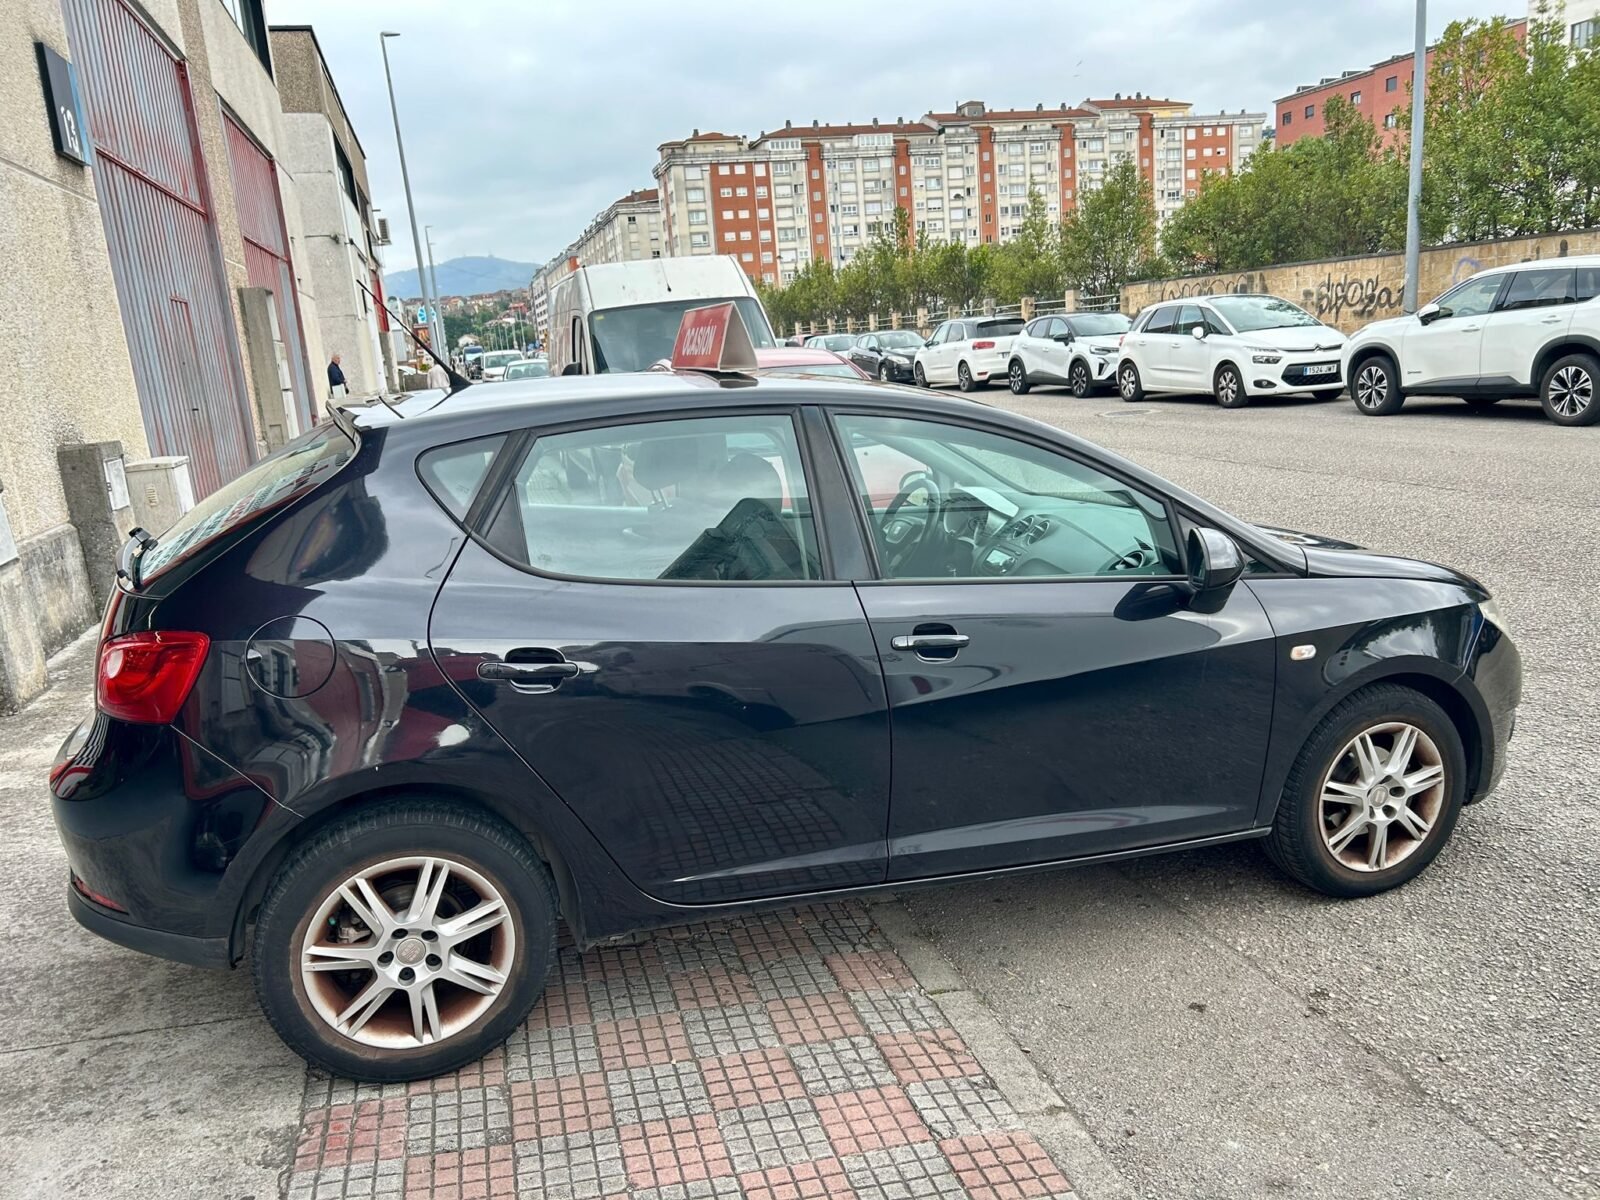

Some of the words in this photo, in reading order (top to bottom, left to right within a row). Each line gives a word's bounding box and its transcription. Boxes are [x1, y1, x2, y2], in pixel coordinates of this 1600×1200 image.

[60, 105, 80, 153] 13
[681, 318, 717, 356] OCASIÓN
[1309, 366, 1323, 374] 1524
